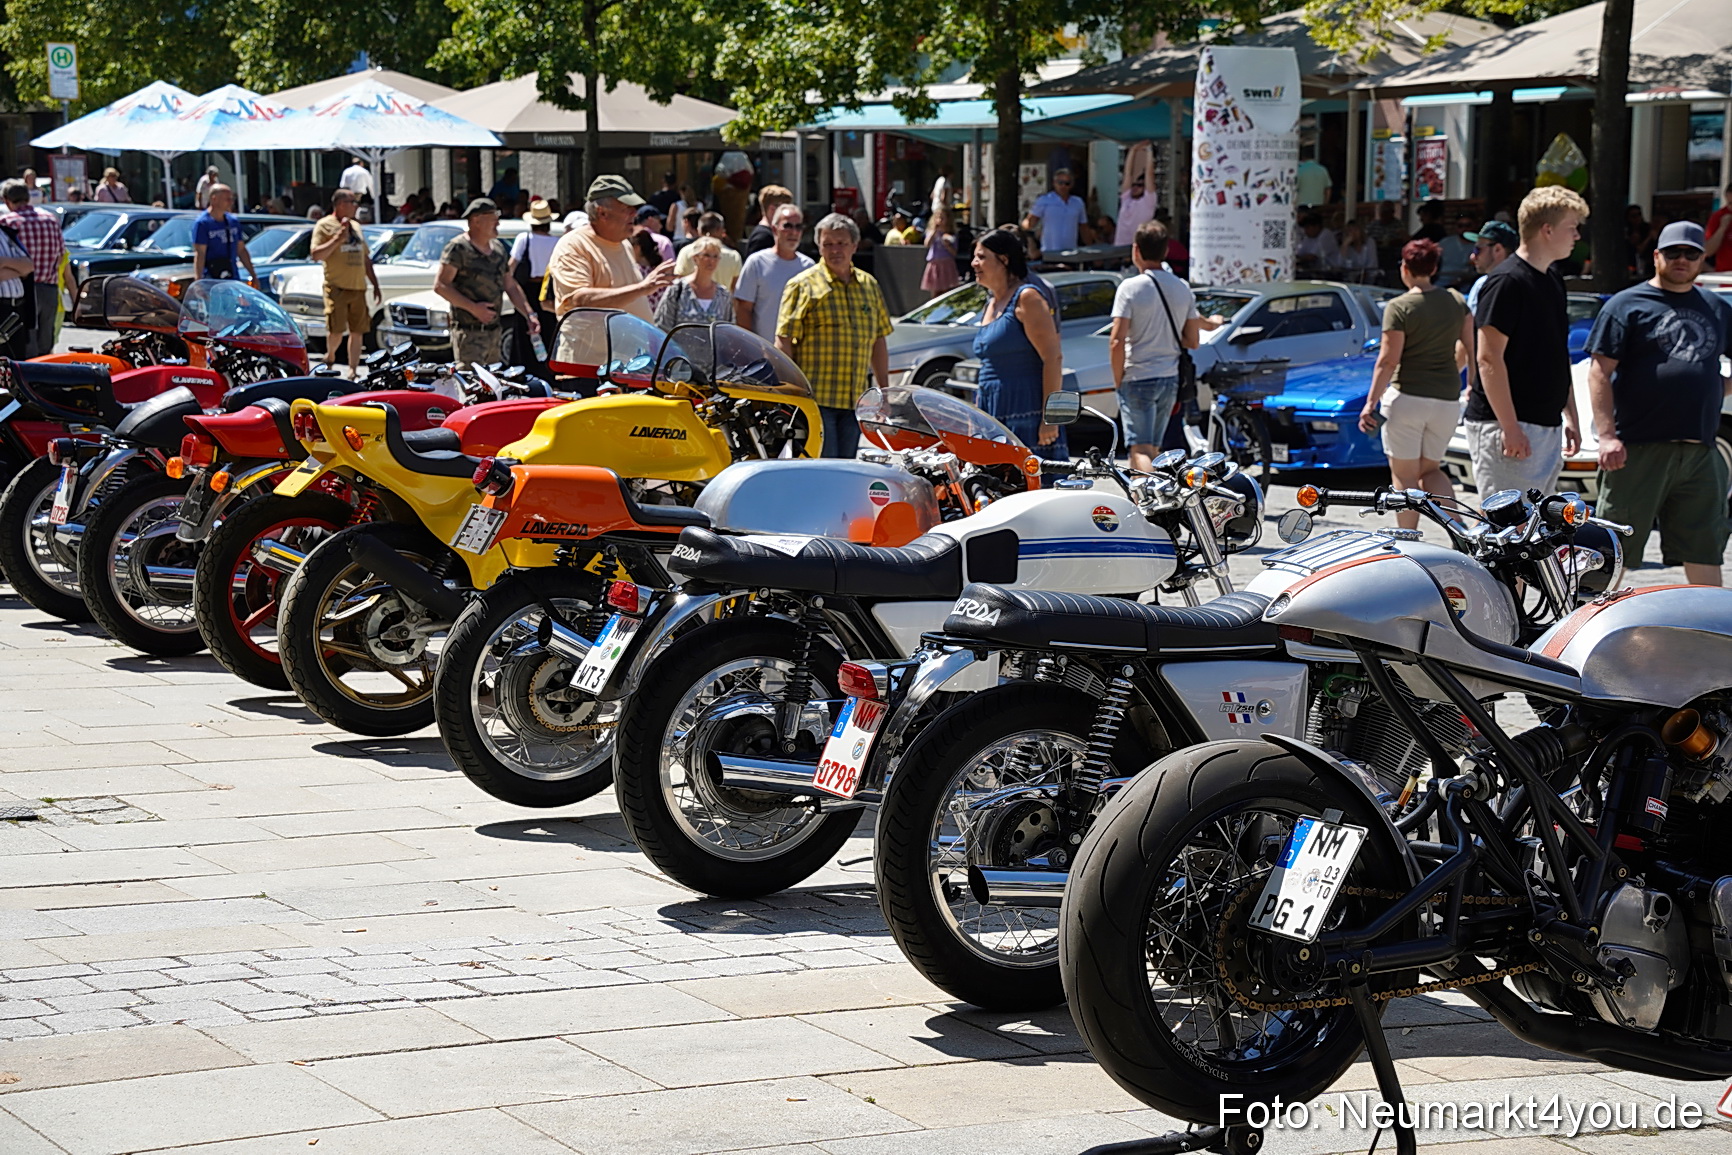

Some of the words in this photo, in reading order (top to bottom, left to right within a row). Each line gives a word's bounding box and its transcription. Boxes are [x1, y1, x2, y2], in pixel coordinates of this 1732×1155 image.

[1243, 88, 1272, 98] swn
[629, 426, 687, 440] LAVERDA
[520, 521, 589, 536] LAVERDA
[853, 702, 881, 731] NM
[817, 758, 857, 793] 0798
[1308, 824, 1349, 861] NM
[1284, 849, 1295, 862] D
[1324, 865, 1340, 880] 03
[1316, 884, 1331, 900] 10
[1258, 893, 1294, 930] PG
[1294, 904, 1315, 936] 1
[1170, 1036, 1229, 1081] MOTOR-UPCYCLES
